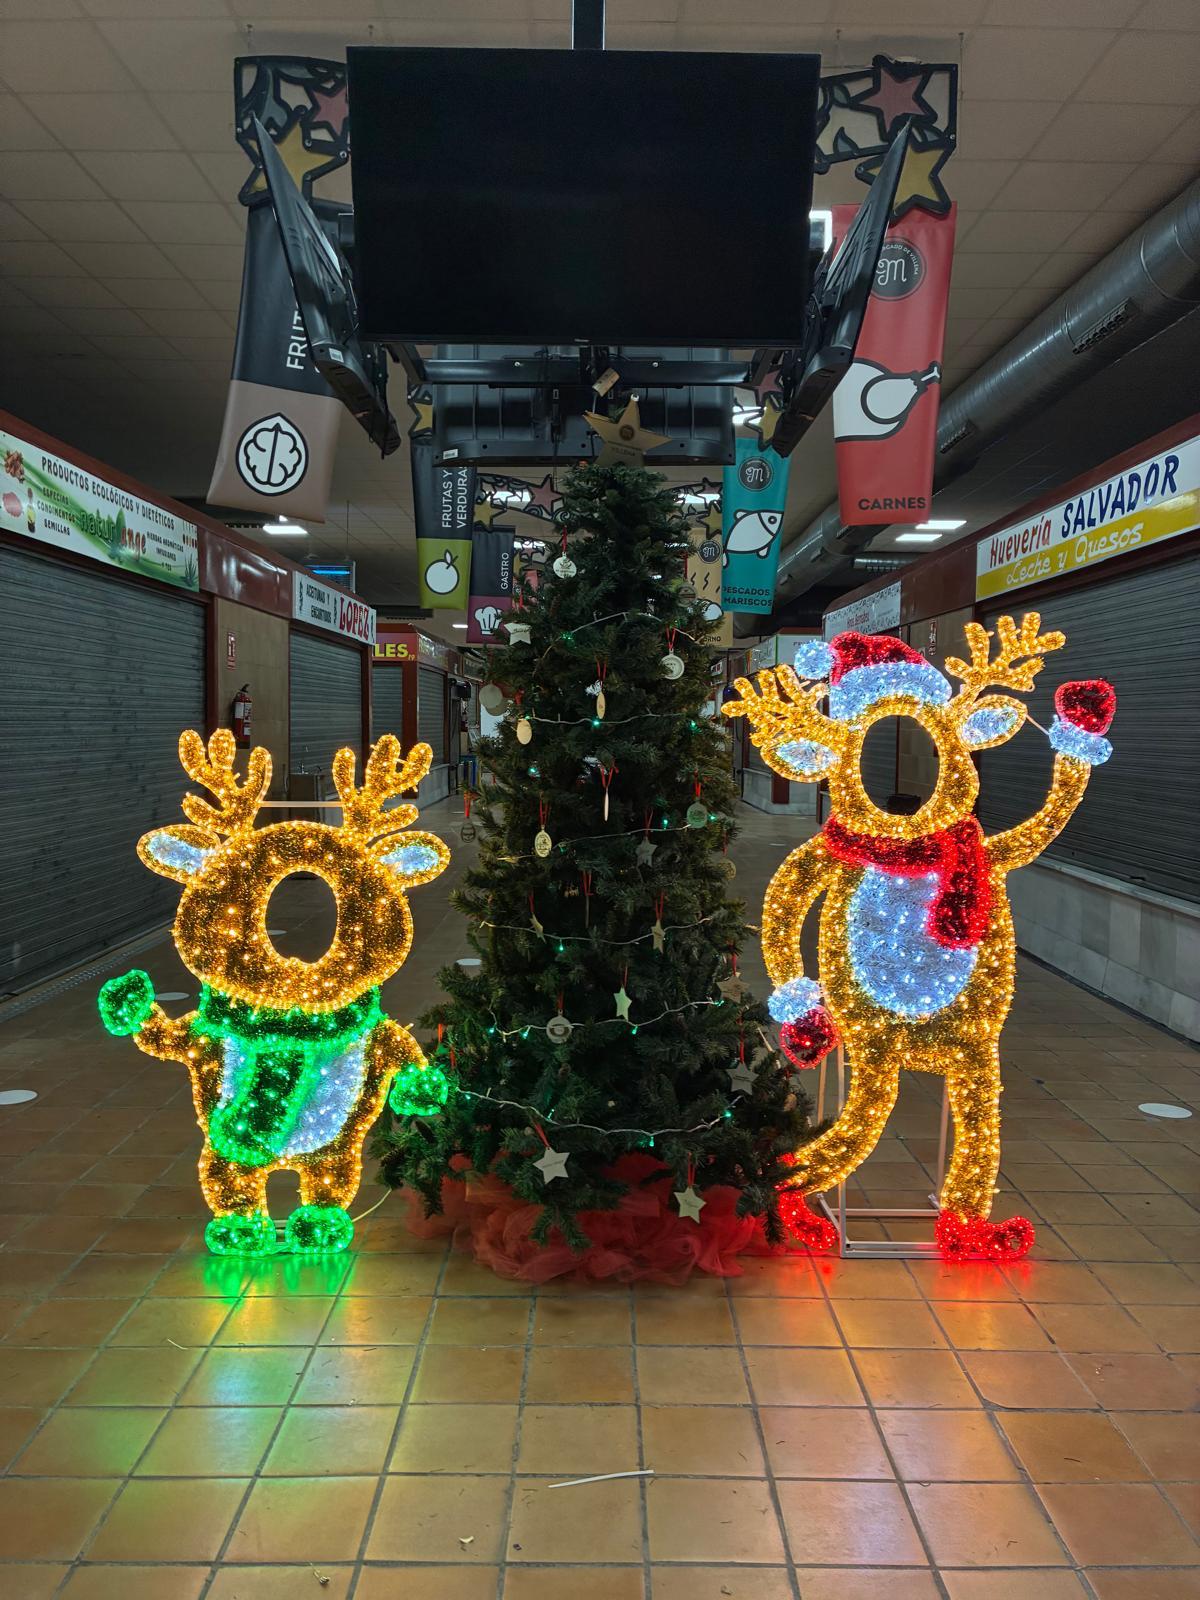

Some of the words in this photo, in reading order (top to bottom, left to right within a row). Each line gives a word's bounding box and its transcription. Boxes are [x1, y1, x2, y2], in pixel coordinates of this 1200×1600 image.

[41, 456, 90, 492] PRODUCTOS
[92, 481, 134, 513] ECOLÓGICOS
[135, 502, 140, 515] Y
[142, 504, 175, 531] DIETÉTICOS
[442, 469, 453, 478] Y
[43, 487, 69, 506] ESPECIAS
[442, 481, 453, 528] FRUTAS
[456, 467, 468, 529] VERDURA
[858, 497, 926, 511] CARNES
[989, 515, 1052, 569] Huevería
[1061, 454, 1180, 539] SALVADOR
[44, 518, 71, 536] SEMILLAS
[500, 552, 509, 590] GASTRO
[1006, 552, 1051, 584] Leche
[1057, 551, 1067, 572] y
[1074, 522, 1144, 562] Quesos
[339, 597, 369, 641] LOPEZ
[724, 597, 773, 607] MARISCOS
